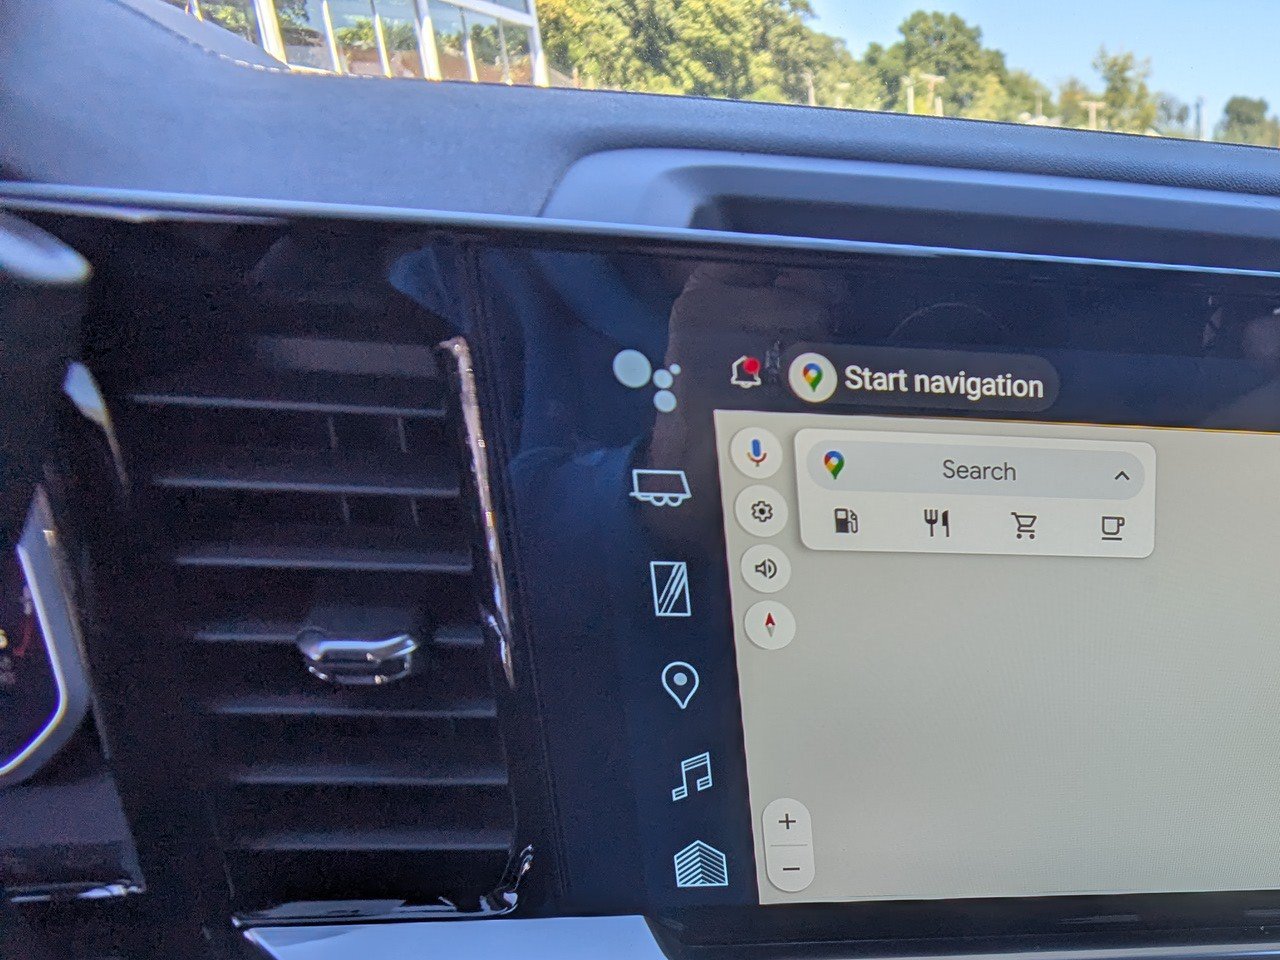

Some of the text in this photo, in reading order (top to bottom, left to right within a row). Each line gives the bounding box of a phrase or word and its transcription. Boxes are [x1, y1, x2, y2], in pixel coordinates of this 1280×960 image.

[845, 364, 1044, 401] Start navigation
[942, 459, 1017, 482] Search
